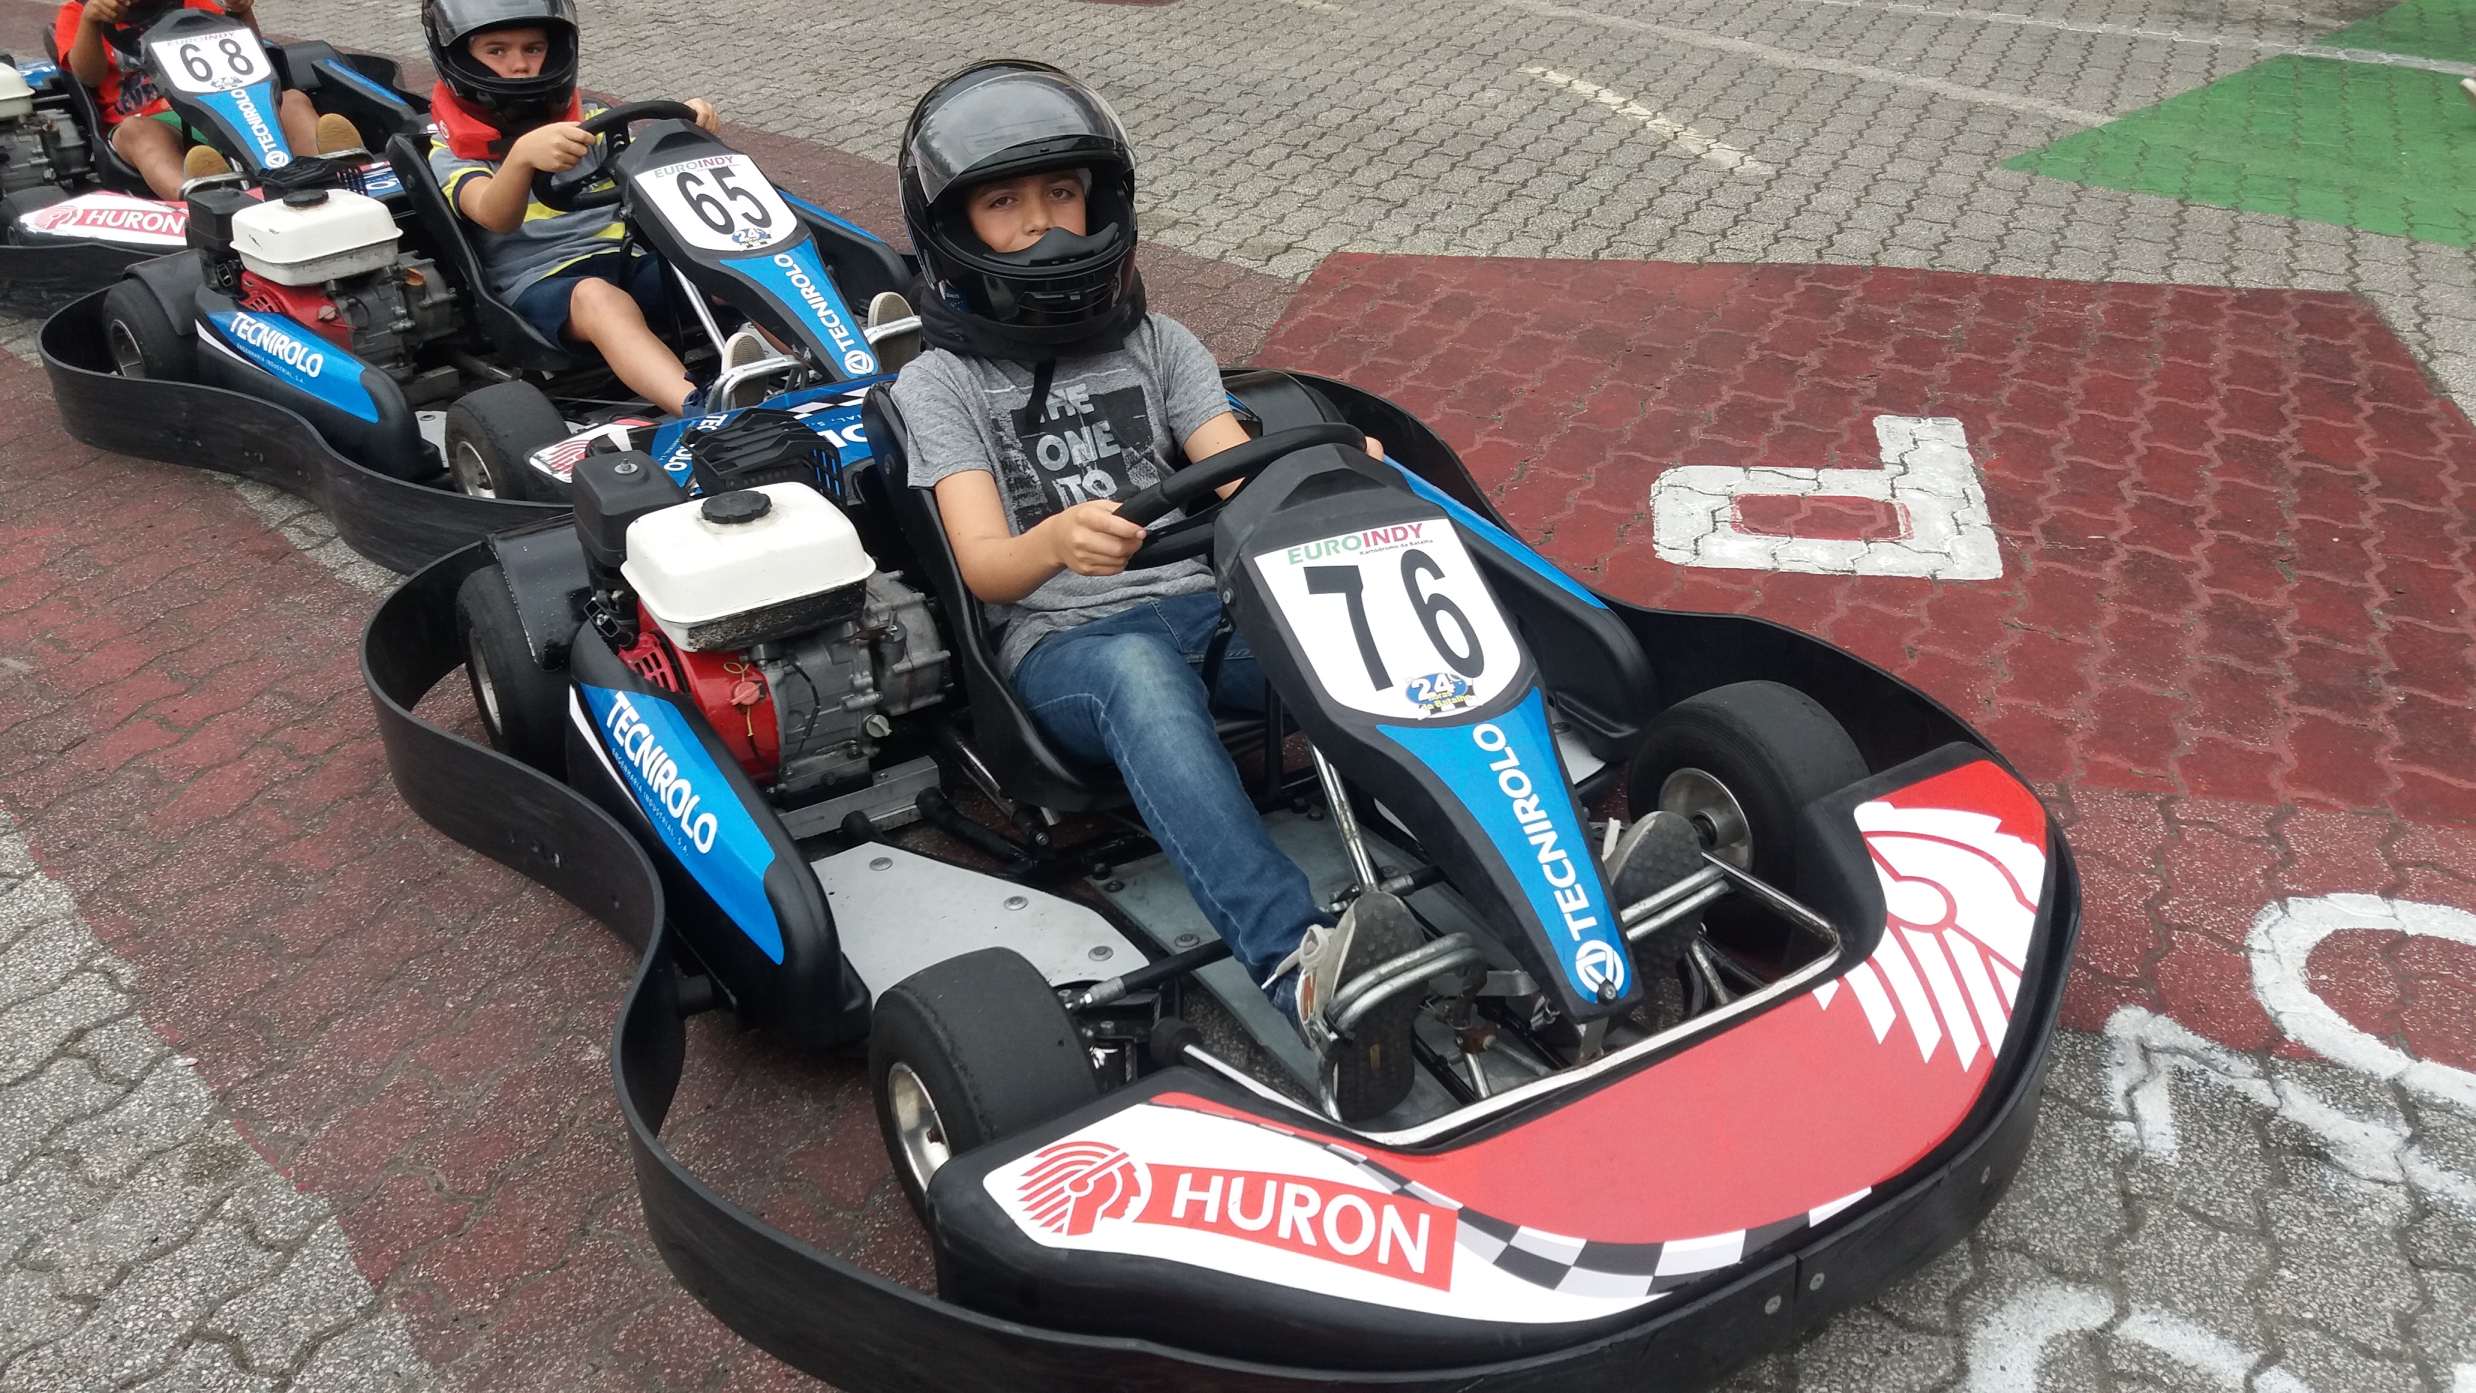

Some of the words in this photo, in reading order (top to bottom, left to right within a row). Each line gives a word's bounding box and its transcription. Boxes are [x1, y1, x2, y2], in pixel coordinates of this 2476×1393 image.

[180, 38, 254, 83] 68
[230, 88, 277, 153] TECNIROLO
[654, 155, 735, 179] EUROINDY
[86, 210, 186, 235] HURON
[676, 166, 772, 235] 65
[774, 253, 855, 353] TECNIROLO
[230, 311, 324, 378] TECNIROLO
[1039, 383, 1094, 424] HE
[1036, 420, 1121, 472] ONE
[1287, 522, 1423, 566] EUROINDY
[1303, 548, 1485, 692] 76
[606, 690, 718, 854] TECNIROLO
[1472, 723, 1599, 942] TECNIROLO
[1171, 1172, 1431, 1275] HURON
